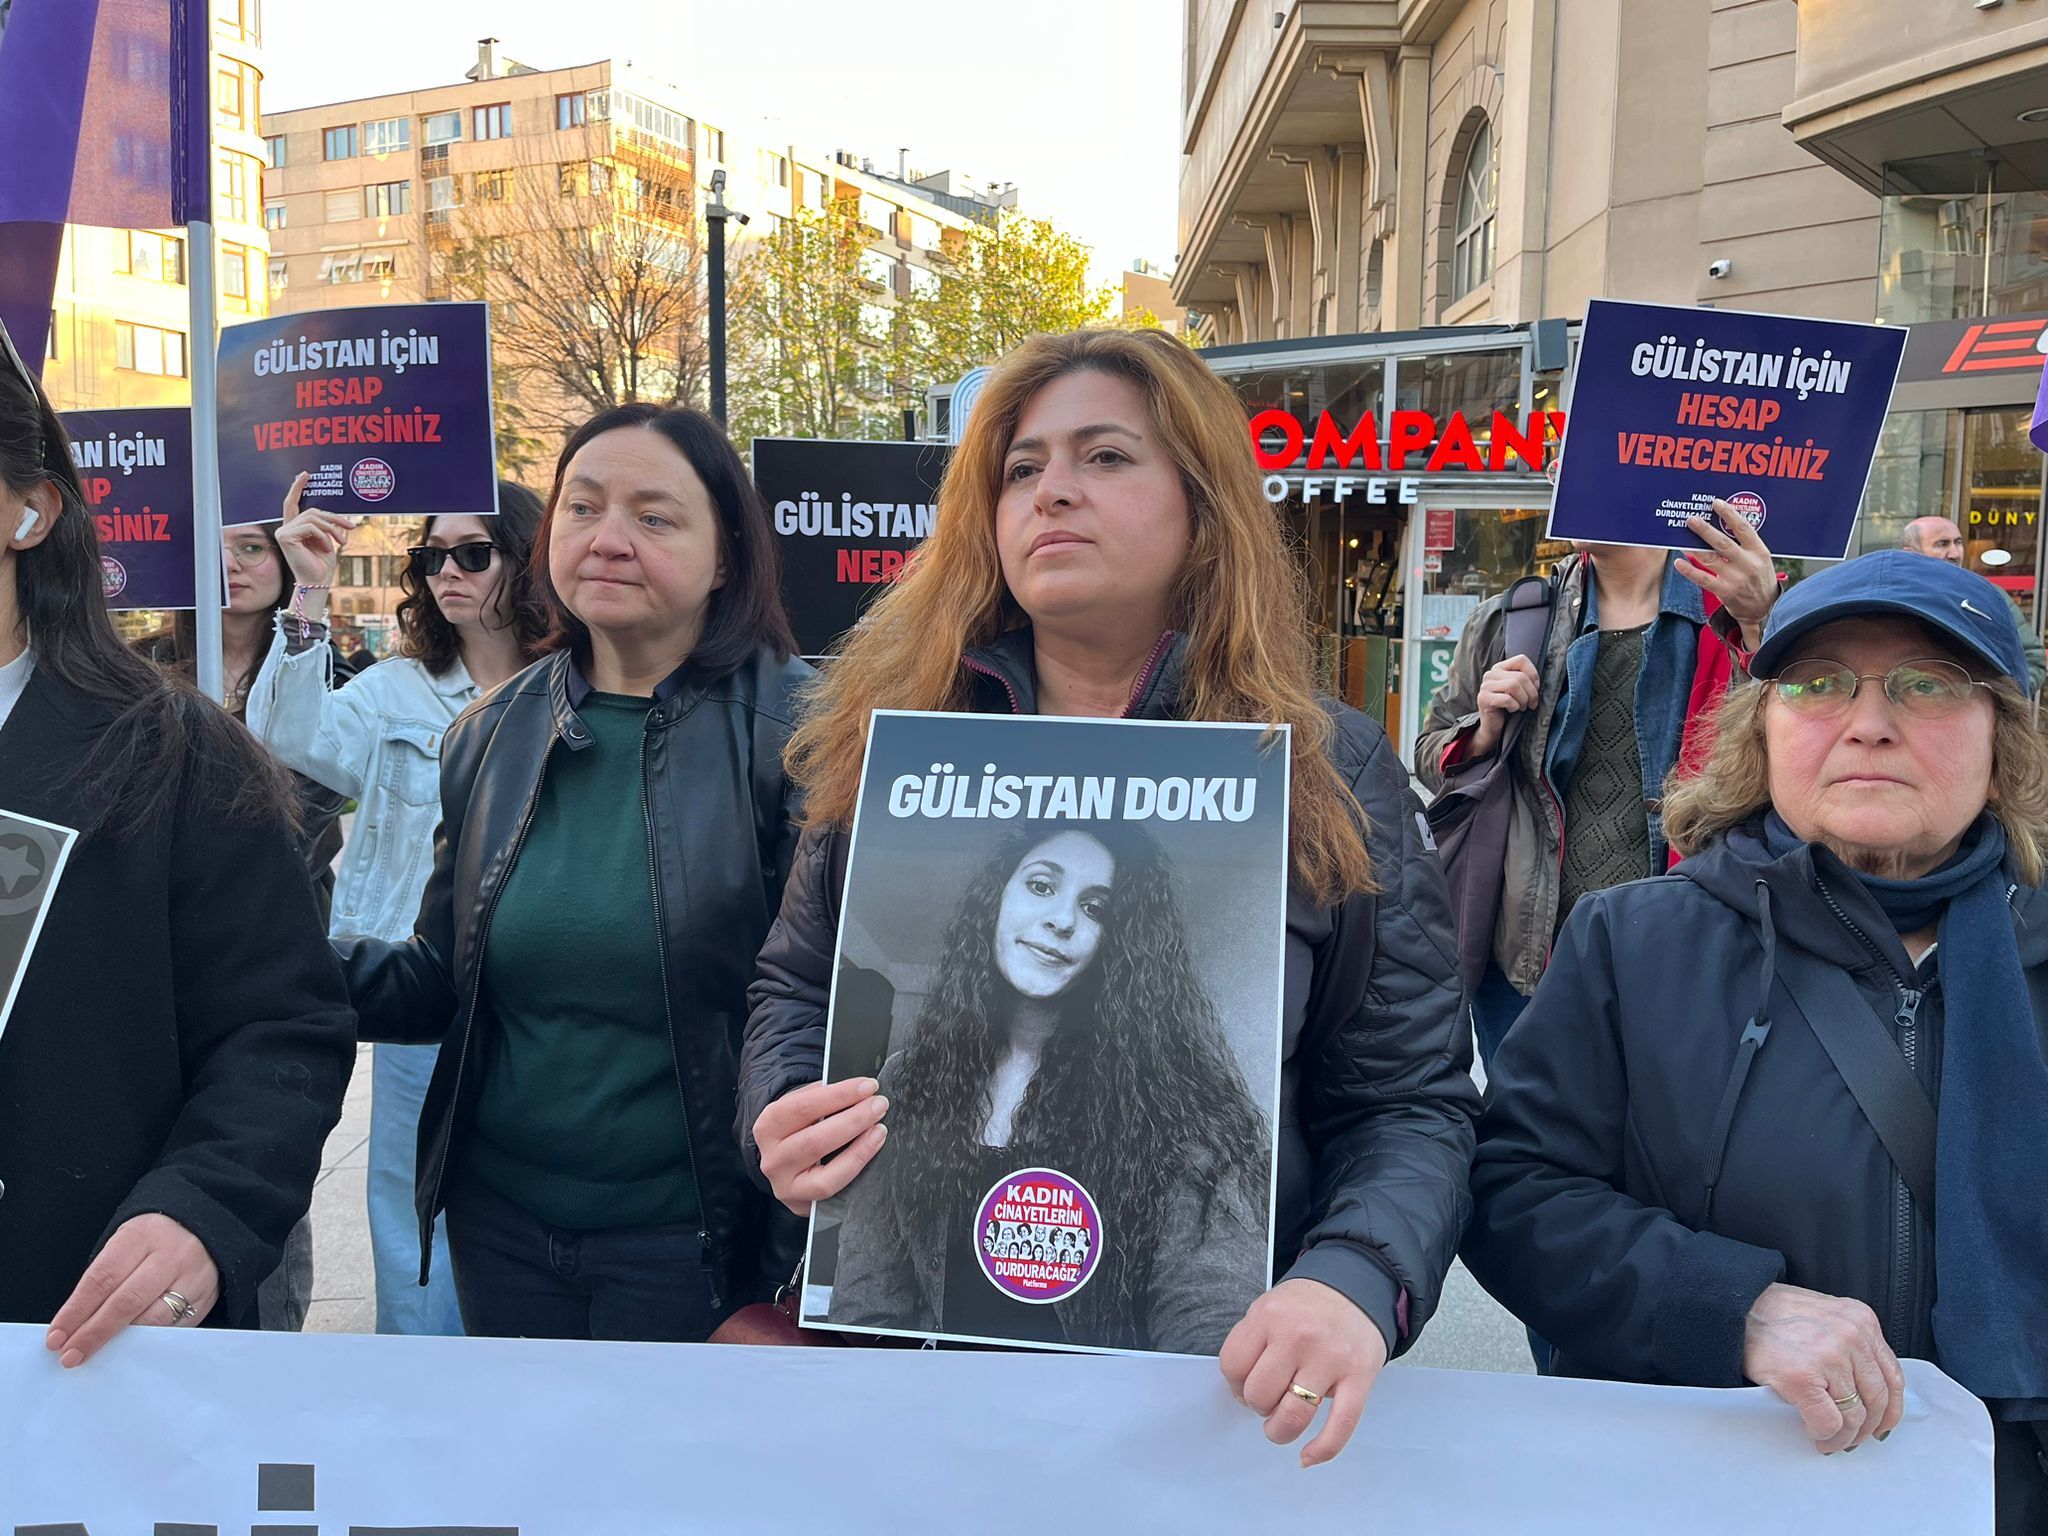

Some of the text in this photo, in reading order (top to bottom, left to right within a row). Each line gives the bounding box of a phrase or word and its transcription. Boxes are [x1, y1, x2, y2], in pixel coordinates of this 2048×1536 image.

[254, 328, 439, 377] GÜLİSTAN İÇİN
[1631, 335, 1852, 400] GÜLİSTAN İÇİN
[296, 376, 383, 409] HESAP
[253, 406, 442, 452] VERECEKSİNİZ
[1676, 392, 1781, 431] HESAP
[108, 431, 166, 476] İÇİN
[1249, 408, 1566, 472] OMPAN
[1617, 432, 1830, 480] VERECEKSİNİZ
[303, 488, 344, 496] PLATFORMU
[1263, 475, 1421, 505] OFFEE
[1692, 494, 1716, 502] KADIN
[1732, 497, 1758, 505] KADIN
[93, 506, 171, 542] SİNİZ
[774, 491, 938, 538] GÜLİSTAN
[888, 762, 1257, 821] GÜLİSTAN DOKU
[994, 1201, 1083, 1226] CİNAYETLERİNİ
[1006, 1184, 1074, 1206] KADIN
[995, 1261, 1078, 1282] DURDURACAĞIZ
